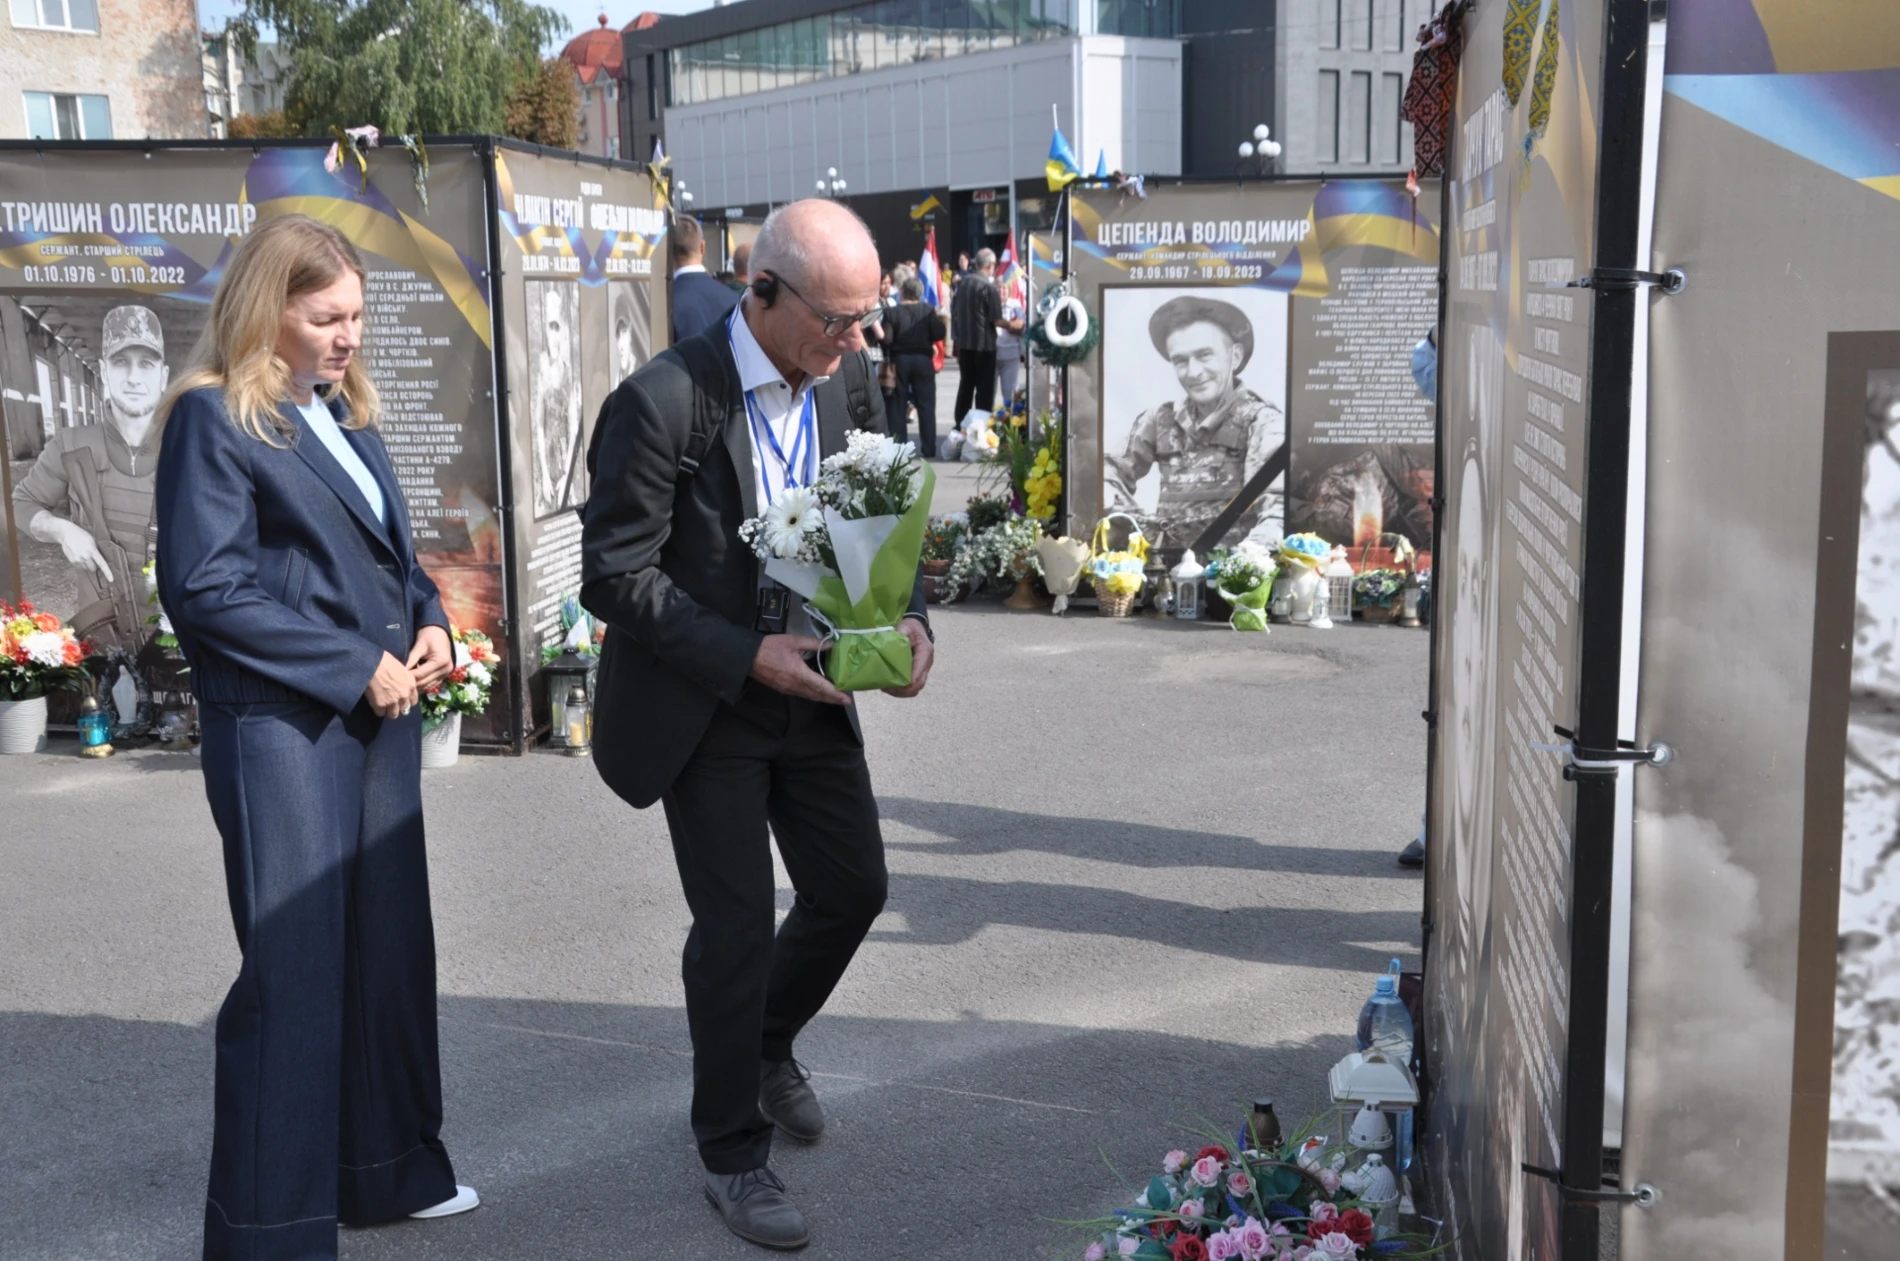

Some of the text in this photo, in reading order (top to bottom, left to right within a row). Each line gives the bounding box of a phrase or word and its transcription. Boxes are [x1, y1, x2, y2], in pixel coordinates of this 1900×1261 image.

[0, 202, 257, 236] ТРИШИН ОЛЕКСАНДР
[1098, 220, 1311, 246] ЦЕПЕНДА ВОЛОДИМИР
[84, 245, 122, 256] СТАРШИЙ
[124, 246, 164, 257] СТРІЛЕЦЬ
[24, 266, 96, 283] 01.10.1976
[111, 267, 185, 284] 01.10.2022
[367, 282, 383, 290] РОКУ
[380, 292, 416, 301] СЕРЕДНЬОЇ
[420, 293, 444, 301] ШКОЛИ
[400, 392, 433, 400] ОСТОРОНЬ
[394, 402, 402, 410] НА
[395, 424, 426, 432] ЗАХИЩАВ
[429, 424, 462, 432] КОЖНОГО
[394, 456, 423, 464] ЧАСТИНИ
[402, 488, 443, 496] ЕРСОНЩИНІ,
[445, 509, 469, 517] ГЕРОЇВ
